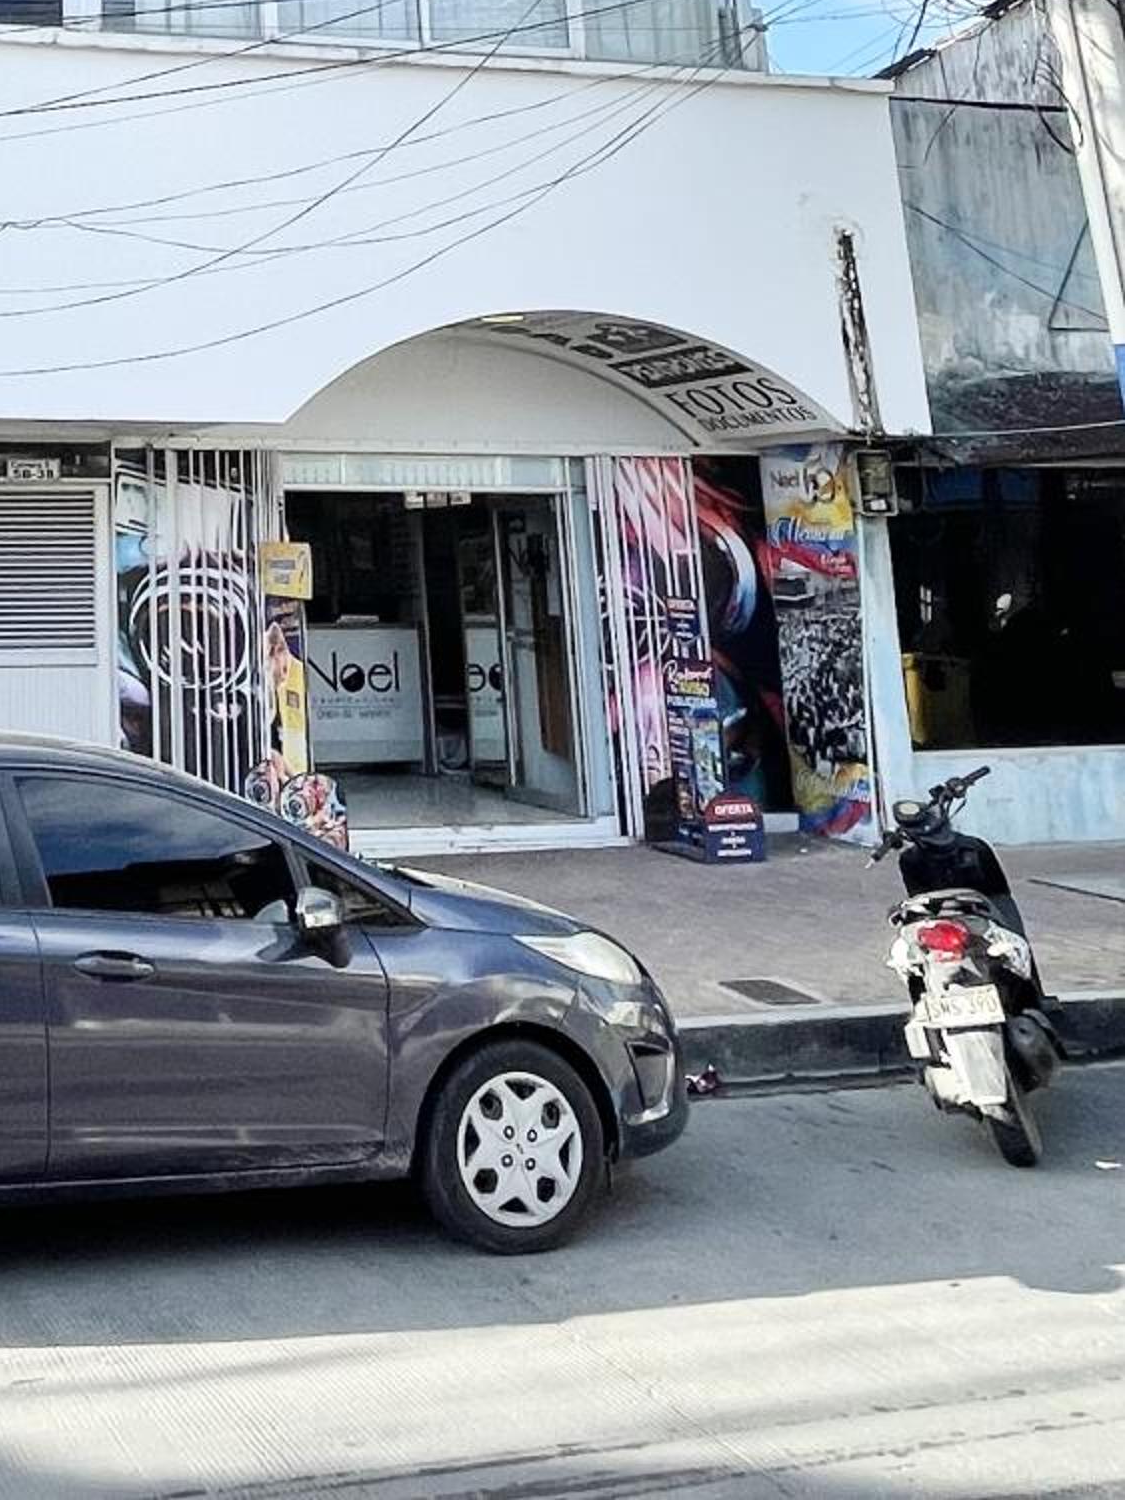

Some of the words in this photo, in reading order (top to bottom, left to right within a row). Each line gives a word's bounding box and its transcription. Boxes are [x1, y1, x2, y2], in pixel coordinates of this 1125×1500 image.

[665, 376, 797, 418] FOTOS
[697, 404, 818, 433] DOCUMENTOS
[307, 652, 400, 693] Noel
[714, 803, 754, 815] OFERTA
